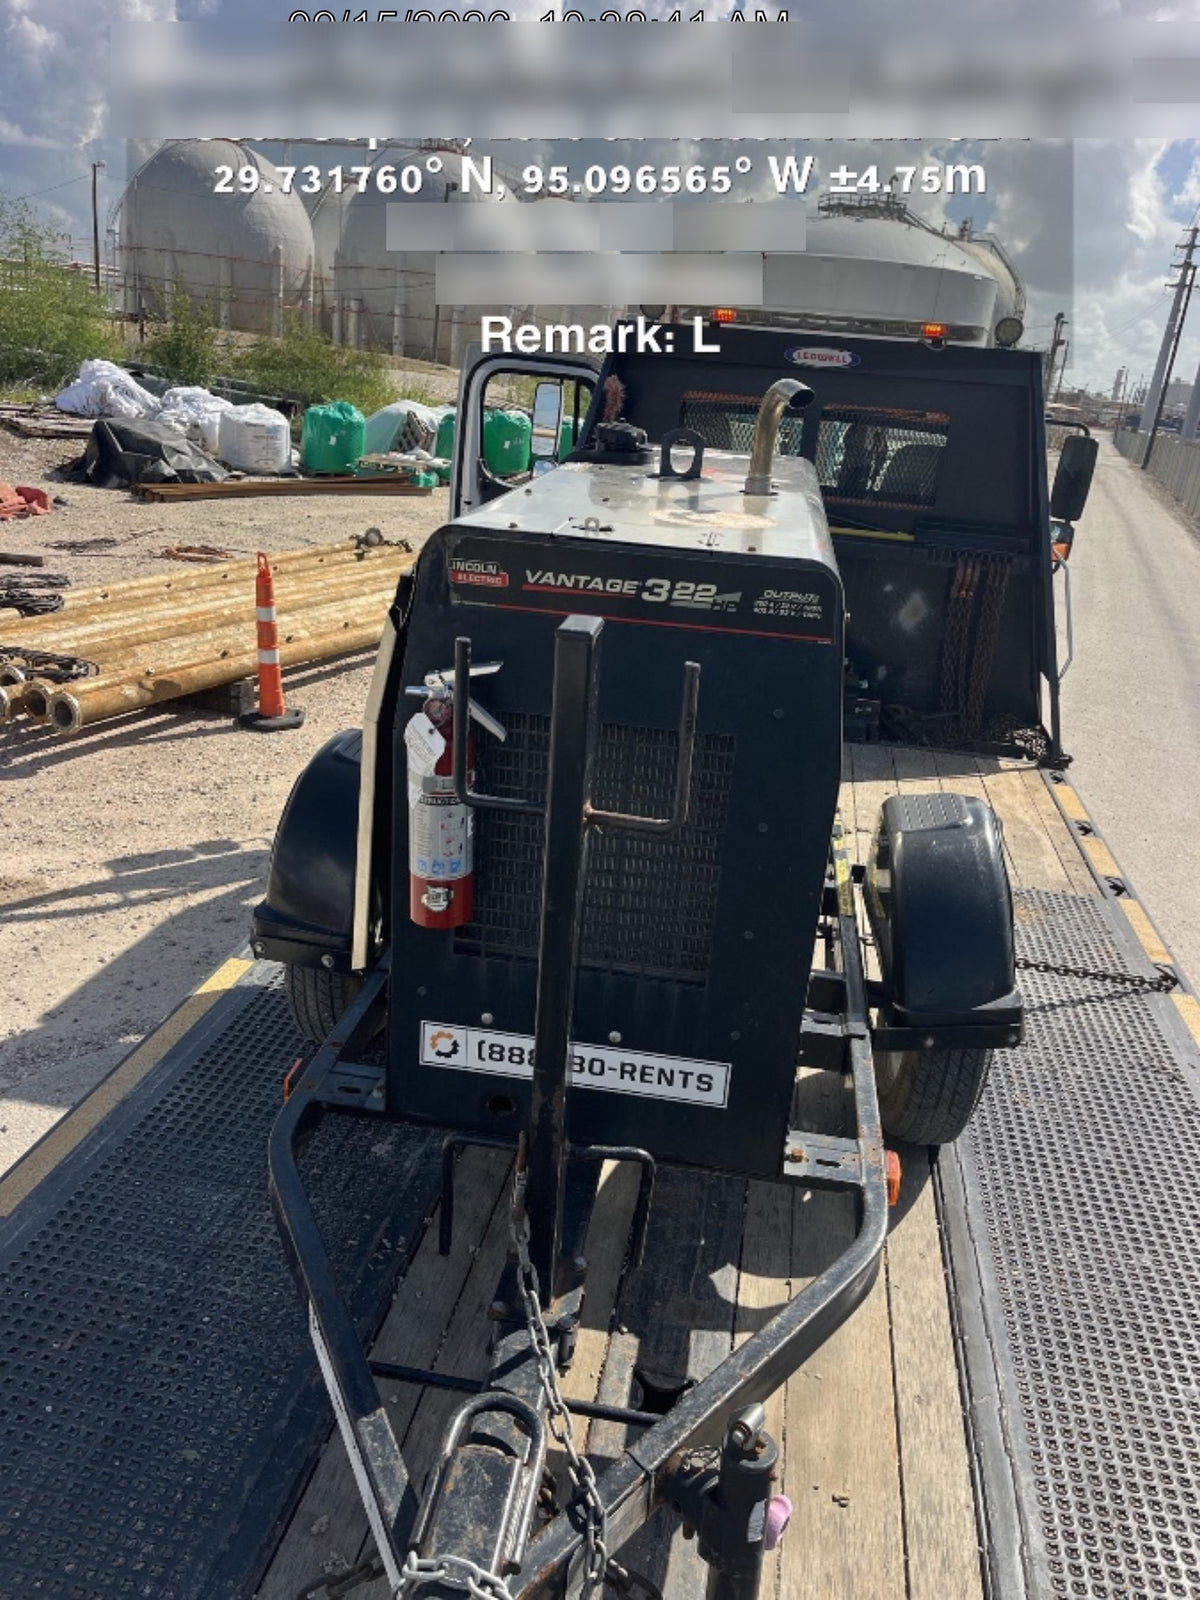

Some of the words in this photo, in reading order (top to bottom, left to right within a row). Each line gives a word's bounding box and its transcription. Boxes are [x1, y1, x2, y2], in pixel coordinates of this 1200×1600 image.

[457, 572, 502, 585] ELECTRIC
[525, 569, 637, 595] VANTAGE
[641, 577, 718, 604] 322
